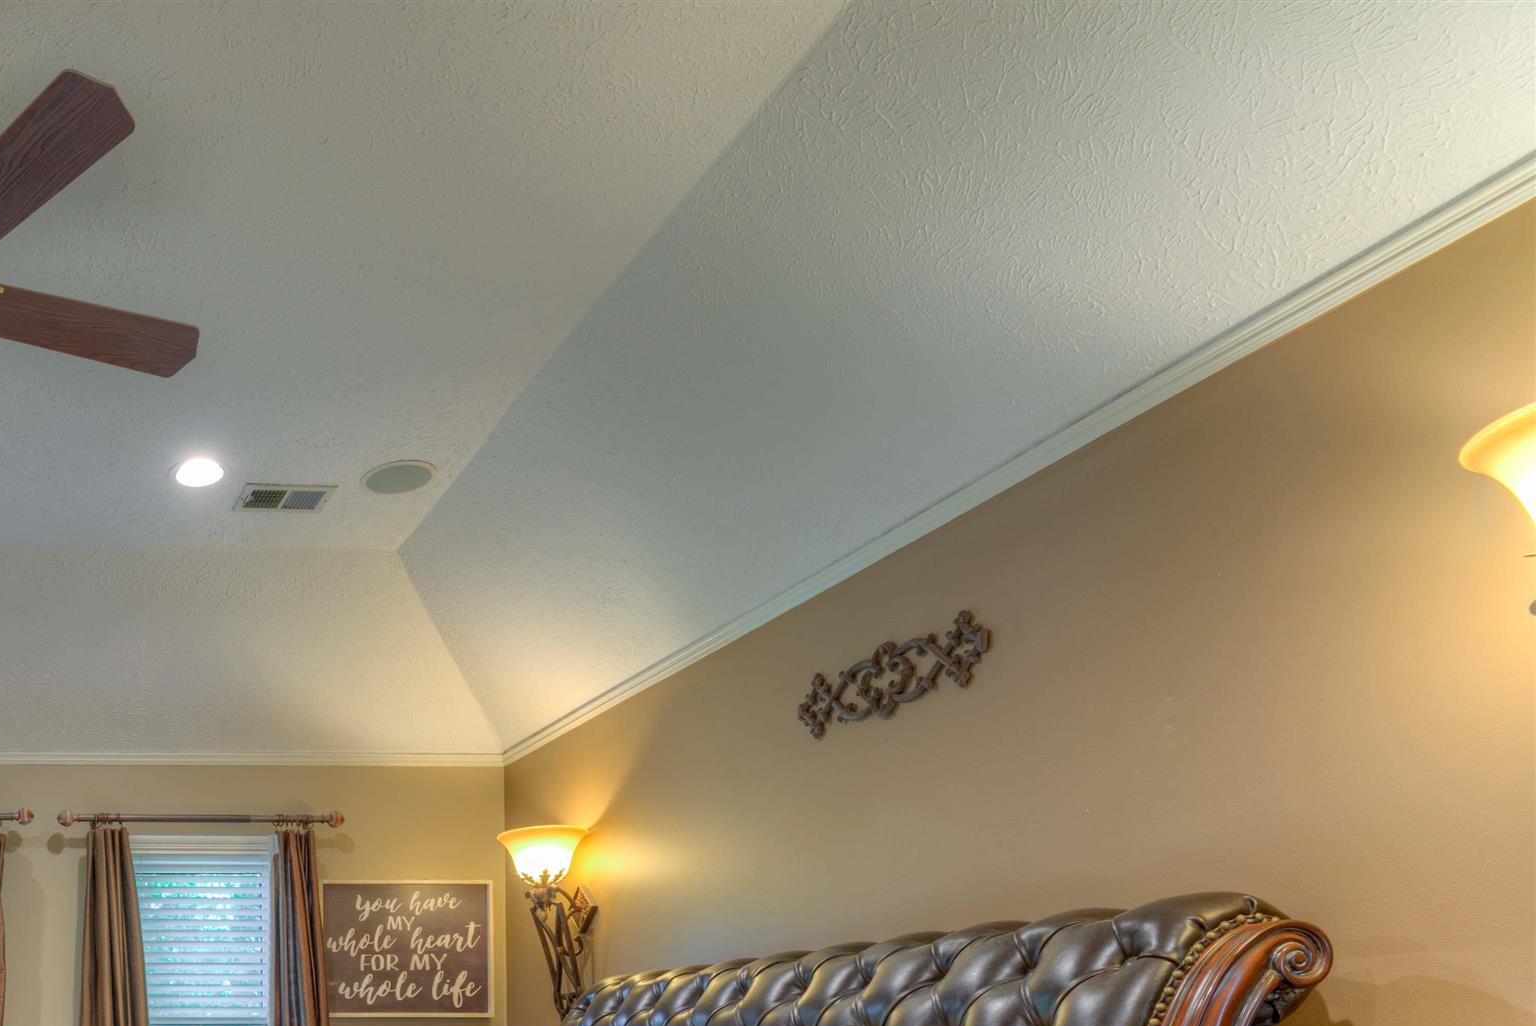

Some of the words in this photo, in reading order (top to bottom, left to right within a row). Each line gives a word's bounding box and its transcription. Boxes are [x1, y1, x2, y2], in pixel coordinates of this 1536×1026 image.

[356, 894, 403, 921] you
[409, 891, 462, 915] have
[327, 925, 396, 956] whole
[410, 921, 481, 955] heart
[387, 916, 415, 931] MY
[360, 954, 399, 971] FOR
[410, 953, 447, 970] MY
[338, 971, 423, 1005] whole
[431, 970, 481, 1008] life
